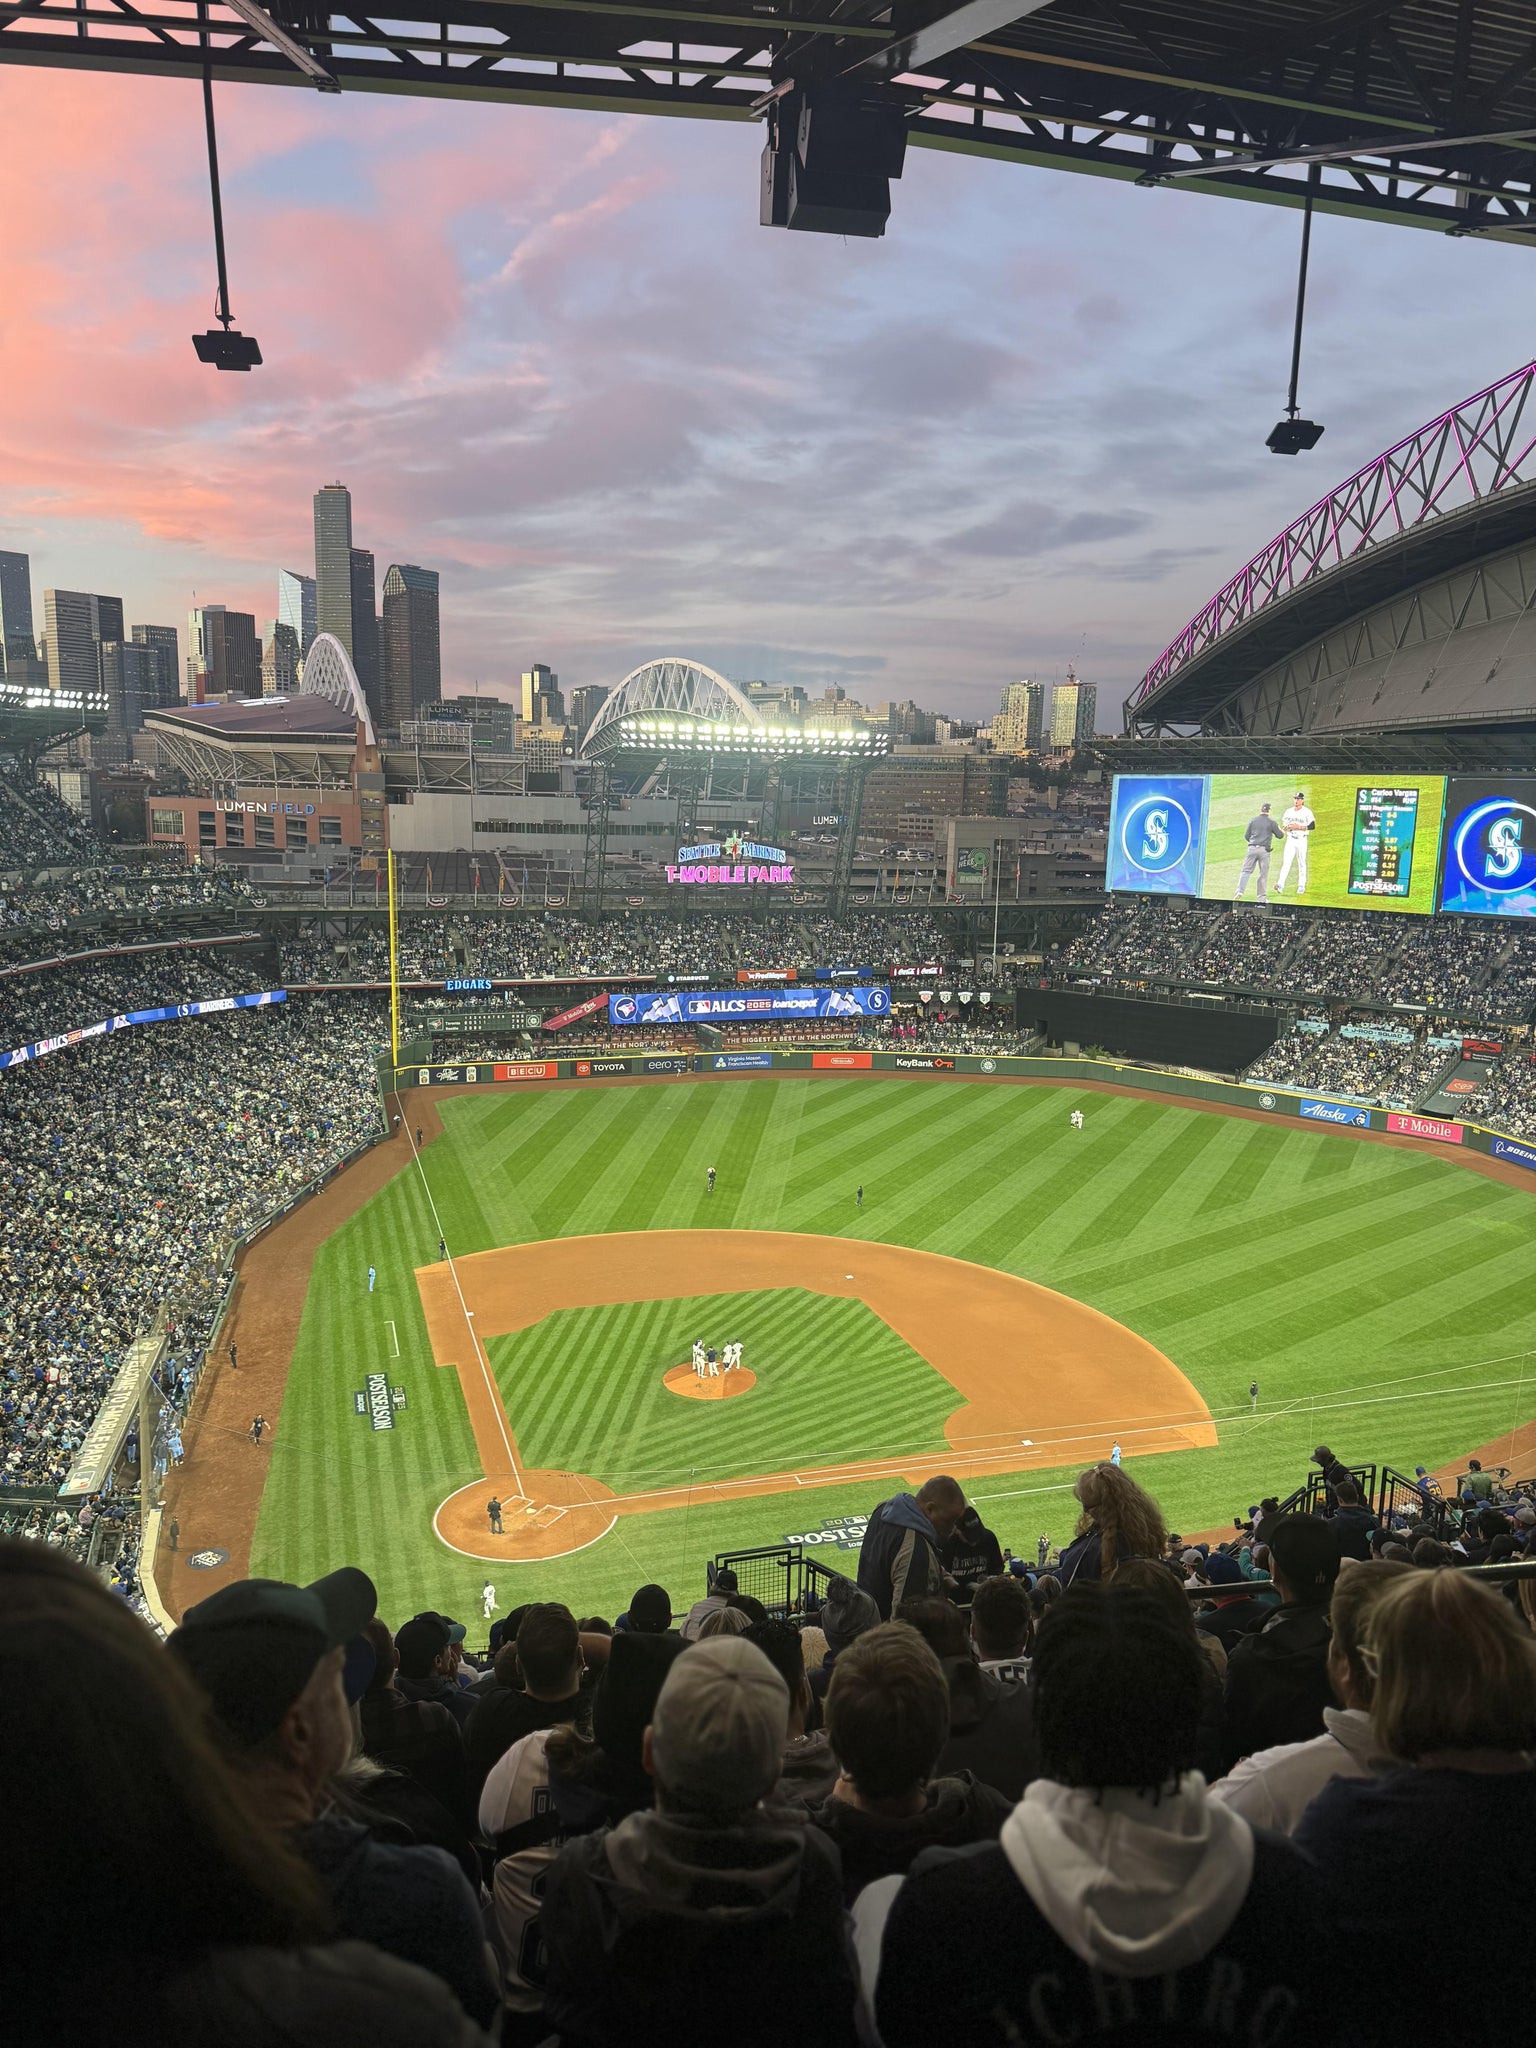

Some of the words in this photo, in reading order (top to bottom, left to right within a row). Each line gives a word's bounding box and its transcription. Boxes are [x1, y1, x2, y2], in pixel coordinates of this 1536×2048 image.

[429, 706, 461, 714] LUMEN
[1371, 789, 1393, 797] Carlos
[1394, 790, 1417, 798] Vargas
[216, 801, 267, 812] LUMEN
[270, 803, 315, 814] FIELD
[813, 816, 838, 825] LUMEN
[678, 843, 721, 862] SEATTLE
[743, 842, 786, 863] MARINERS
[665, 865, 746, 883] T-MOBILE
[748, 865, 795, 883] PARK
[1353, 881, 1403, 892] POSTSEASON
[712, 1000, 746, 1012] ALCS
[747, 1001, 770, 1009] 2025
[1377, 1031, 1403, 1039] SQUAD
[593, 1063, 625, 1072] TOYOTA
[648, 1061, 672, 1069] eero
[896, 1059, 933, 1068] KeyBank
[510, 1067, 543, 1076] BECU
[1303, 1104, 1347, 1121] Alaska
[1411, 1119, 1452, 1137] Mobile
[117, 1353, 149, 1391] WELCOME
[110, 1390, 131, 1404] TO
[368, 1373, 393, 1430] POSTSEASON
[78, 1443, 108, 1470] PARK
